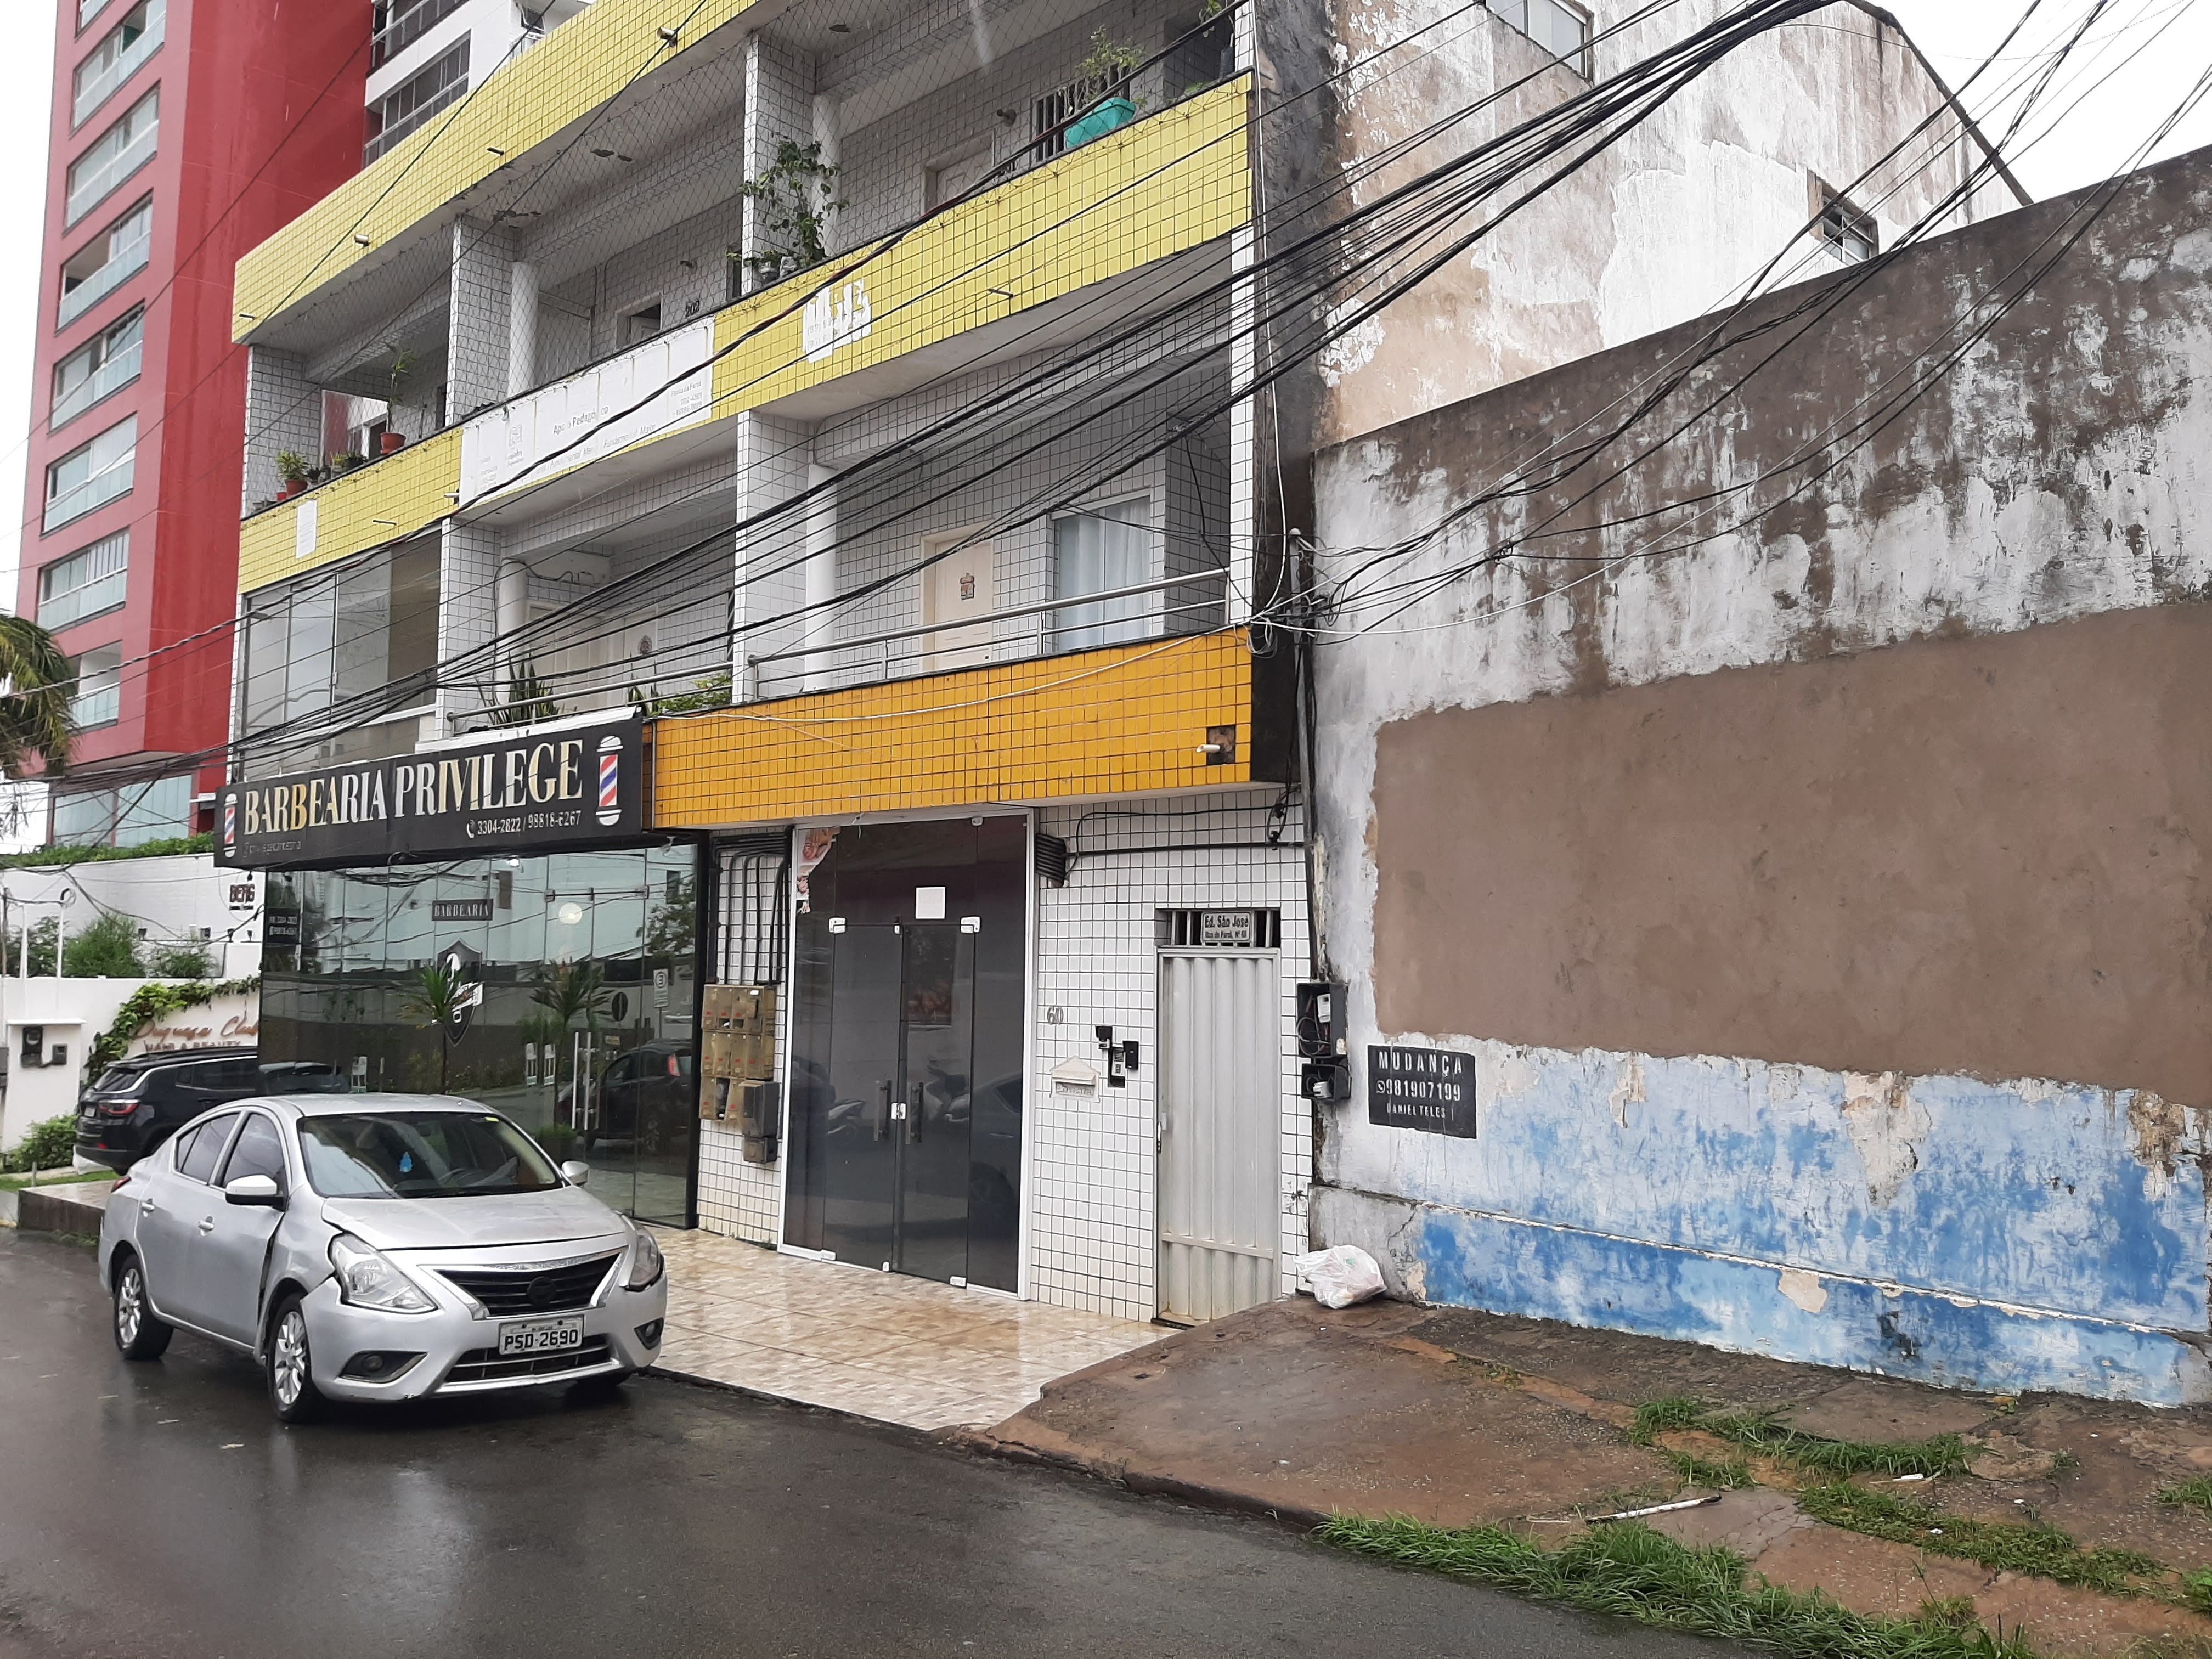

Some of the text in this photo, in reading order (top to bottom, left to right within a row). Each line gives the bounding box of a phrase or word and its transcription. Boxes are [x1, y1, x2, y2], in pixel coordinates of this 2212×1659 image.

[685, 300, 699, 317] 202
[553, 407, 608, 435] Apoo Pedagóco
[244, 740, 583, 835] BARBEARIA PRIVILEGE
[434, 904, 489, 917] BARBEARIA
[1205, 915, 1248, 928] Ed. São José
[1379, 1051, 1462, 1077] MUDANÇA
[1386, 1079, 1461, 1102] 981907199
[1419, 1105, 1446, 1118] TELES
